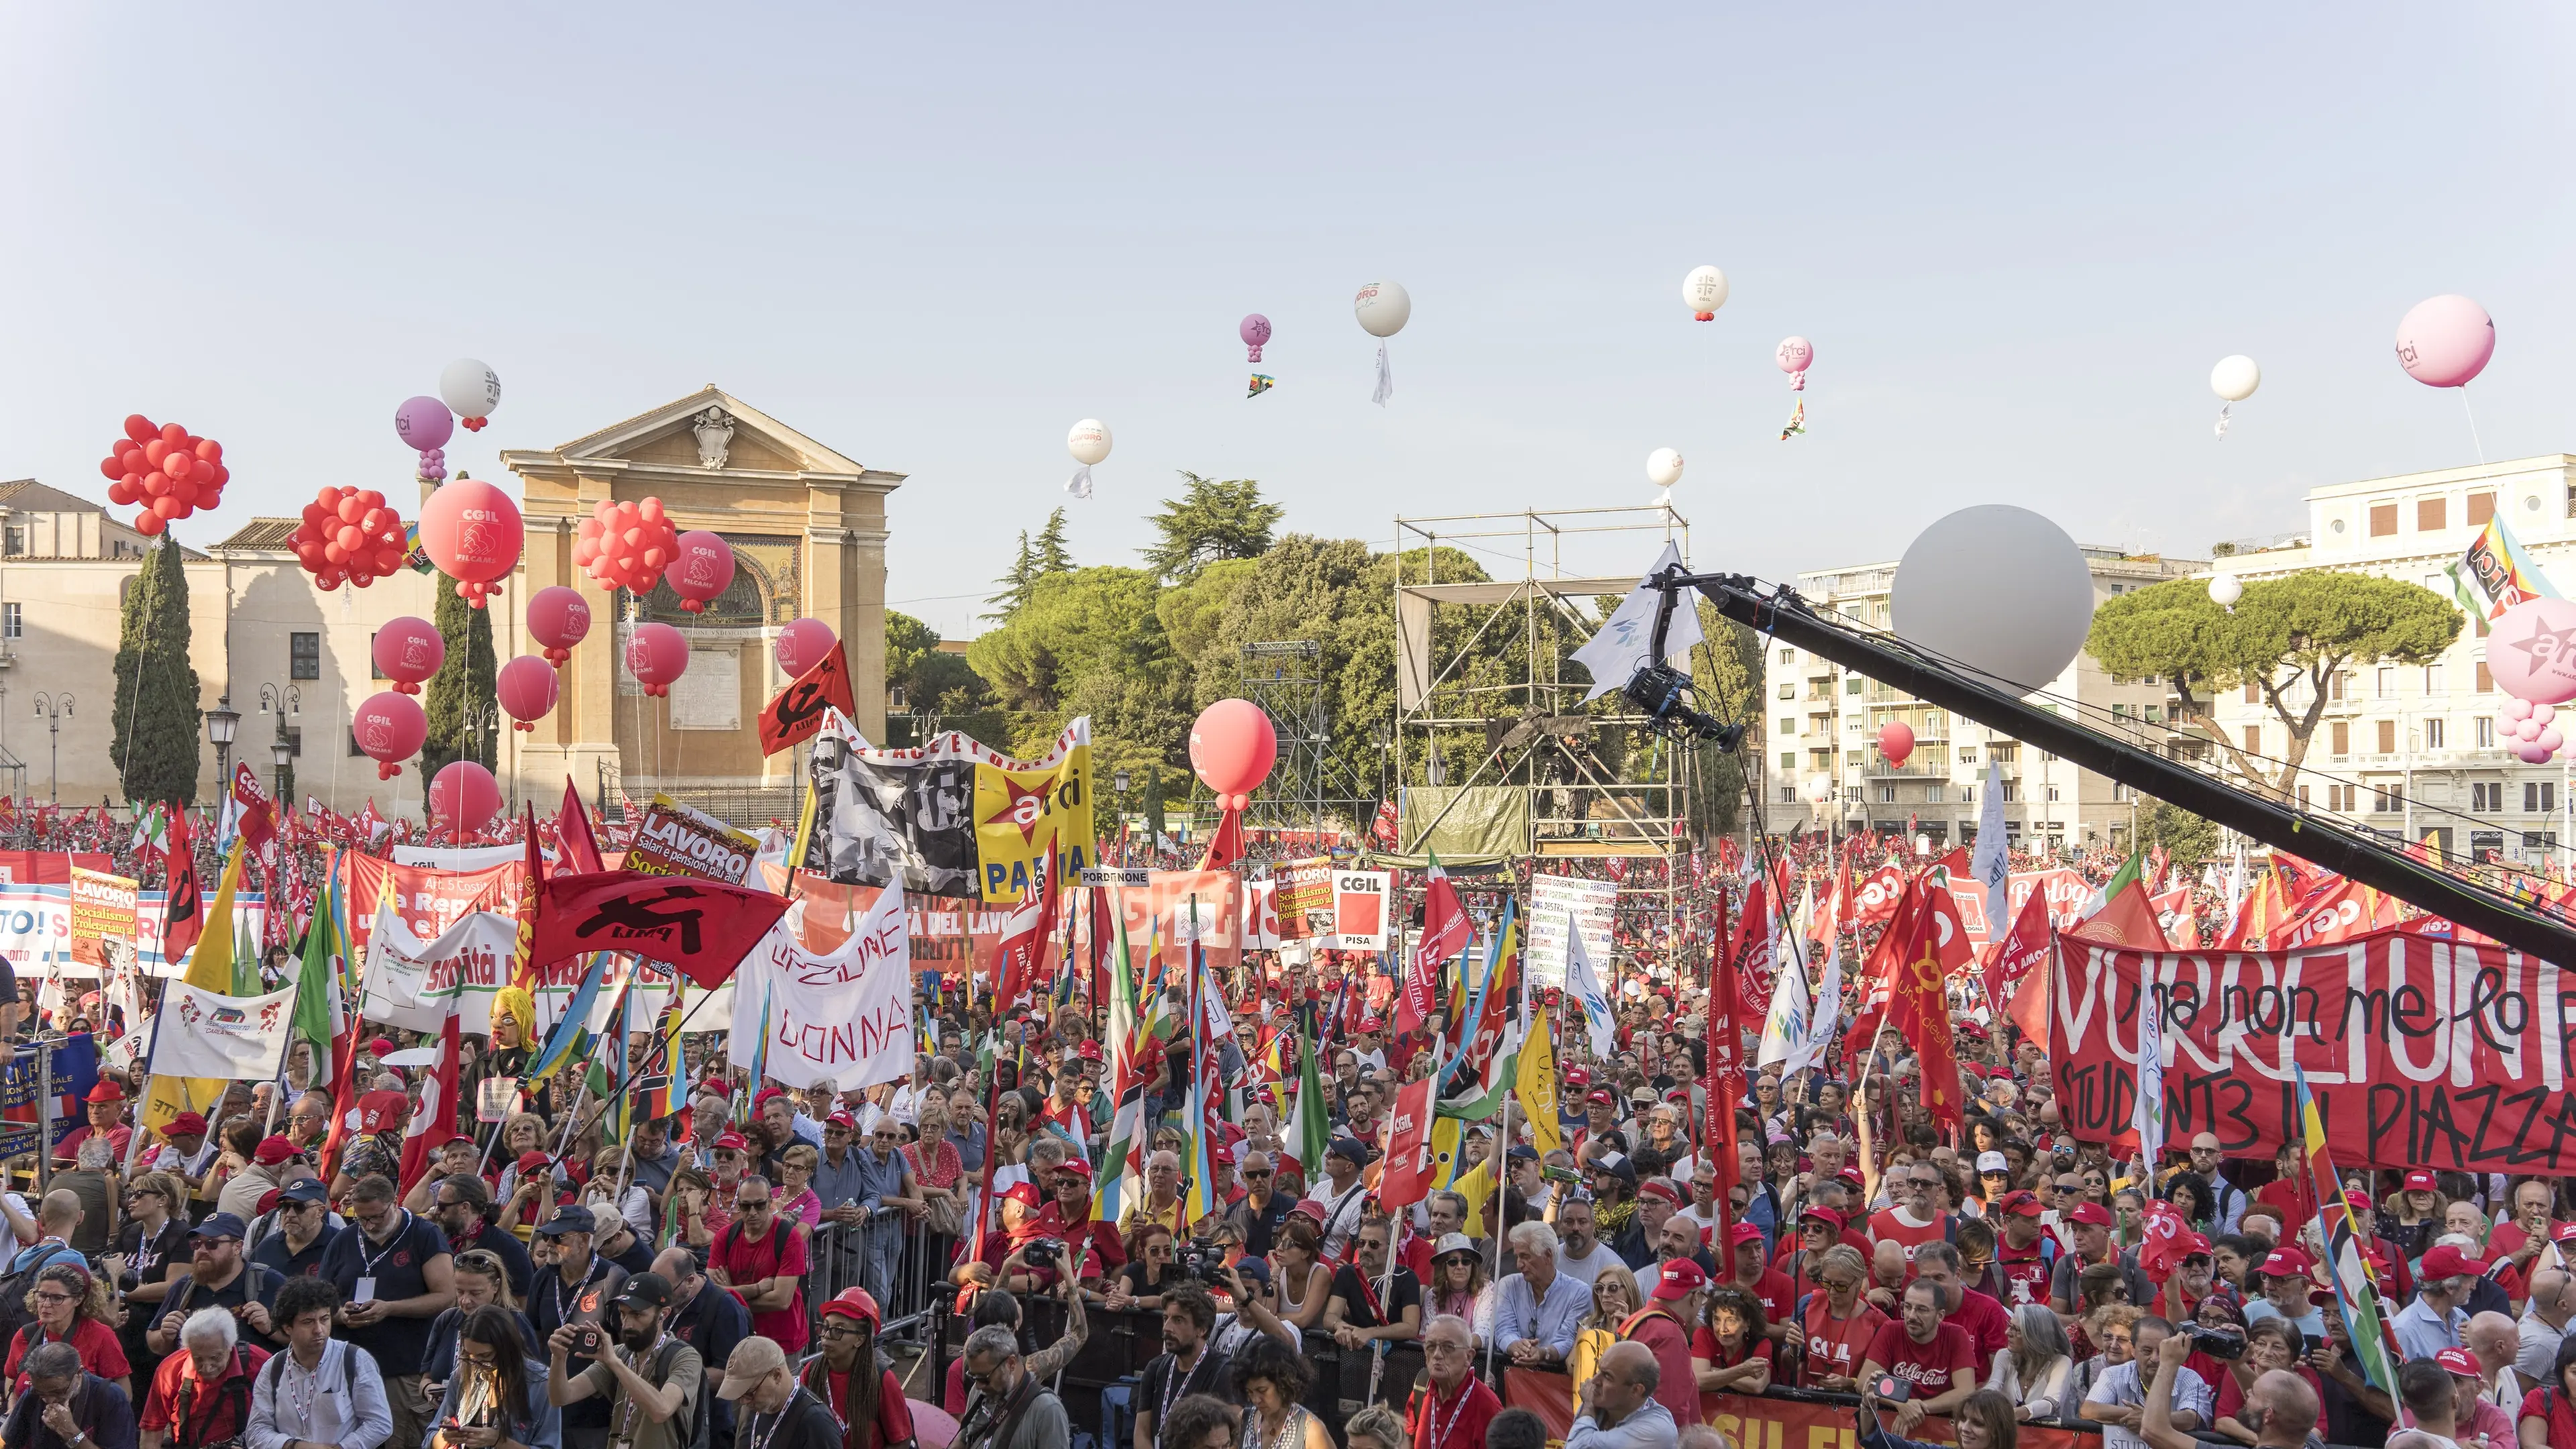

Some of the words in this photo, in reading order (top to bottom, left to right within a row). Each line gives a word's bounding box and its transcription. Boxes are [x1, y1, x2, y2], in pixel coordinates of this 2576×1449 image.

[1784, 345, 1805, 357] arci
[2398, 340, 2418, 364] rci
[396, 415, 411, 431] rci
[462, 509, 498, 523] CGIL
[457, 553, 497, 564] FILCAMS
[692, 546, 717, 559] CGIL
[682, 578, 714, 588] FILCAMS
[568, 604, 587, 613] CGIL
[407, 636, 428, 646] CGIL
[400, 661, 425, 670] FILCAMS
[367, 714, 391, 726] CGIL
[364, 745, 392, 754] FILCAMS
[951, 734, 961, 753] E
[239, 772, 268, 802] CGIL
[642, 812, 747, 875] LAVORO
[637, 835, 664, 853] Salari
[663, 848, 669, 857] e
[669, 850, 710, 873] pensioni
[709, 865, 724, 880] più
[724, 870, 740, 885] alti
[1276, 867, 1330, 884] LAVORO
[425, 878, 443, 890] Art.
[448, 880, 453, 890] 5
[1278, 883, 1291, 891] Salari
[1295, 879, 1315, 889] pensioni
[1340, 877, 1381, 892] CGIL
[1534, 876, 1552, 886] QUESTO
[1552, 879, 1574, 889] GOVERNO
[1589, 882, 1618, 894] ABBATTERE
[73, 880, 135, 906] LAVORO
[1278, 886, 1330, 902] Socialismo
[1582, 893, 1615, 906] COSTITUZIONE
[74, 894, 89, 904] Salari
[93, 900, 116, 908] pensioni
[1279, 896, 1325, 912] Proletariato
[1326, 893, 1334, 904] al
[74, 904, 134, 923] Socialismo
[1279, 910, 1304, 923] potere
[1544, 902, 1564, 913] DESTRA
[1595, 906, 1614, 918] ODIATO
[73, 916, 125, 934] Proletariato
[127, 925, 136, 936] al
[928, 911, 961, 935] DEL
[968, 911, 1012, 934] LAVO
[1581, 918, 1613, 931] COSTITUZIONE
[73, 928, 101, 941] potere
[1346, 936, 1371, 945] PISA
[1601, 934, 1611, 944] NOI
[1529, 938, 1551, 949] LOTTIAMO
[425, 944, 496, 992] sanità
[649, 961, 675, 976] MELON
[1536, 964, 1566, 975] COSTITUZION
[1534, 974, 1548, 984] FIGLI
[2212, 983, 2327, 1046] non
[2337, 982, 2443, 1045] me
[2452, 966, 2529, 1056] lo
[366, 1116, 376, 1128] SPI
[2061, 1061, 2260, 1152] STUDNT3
[2368, 1085, 2576, 1171] PIAZZA
[1395, 1114, 1413, 1133] CGIL
[1395, 1154, 1407, 1167] FISAC
[2438, 1356, 2467, 1366] BENEVENTO
[2451, 1351, 2465, 1360] CGIL
[1893, 1361, 1922, 1381] Bella
[1921, 1367, 1949, 1385] Ciao
